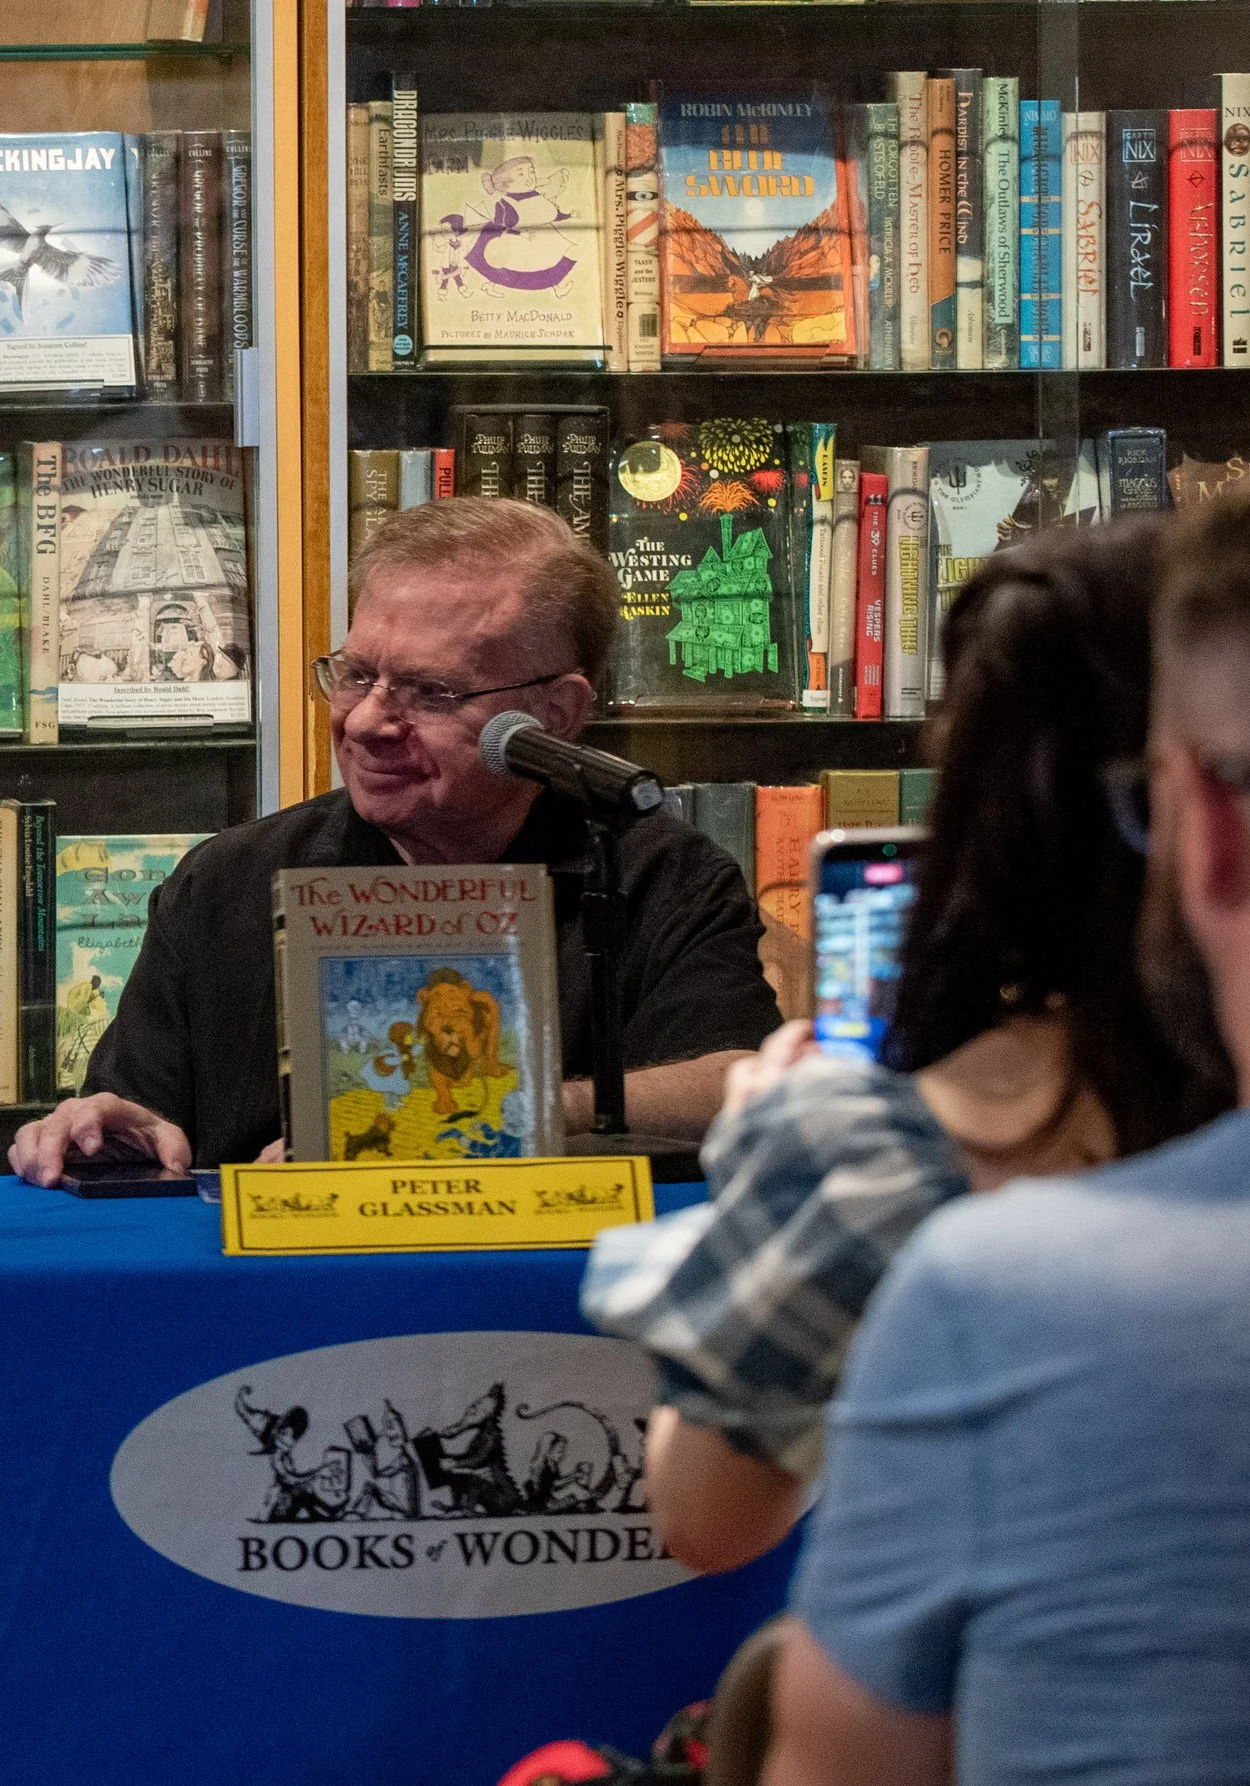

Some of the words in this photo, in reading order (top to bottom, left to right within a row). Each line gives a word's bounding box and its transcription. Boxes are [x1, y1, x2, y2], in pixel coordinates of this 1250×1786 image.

[998, 83, 1008, 144] McKinley
[1226, 108, 1250, 118] NIX
[378, 129, 390, 196] Earthfasts
[998, 150, 1009, 173] The
[1126, 142, 1154, 159] NIX
[233, 165, 246, 208] GREGOR
[686, 175, 814, 196] SWORD
[939, 150, 951, 203] HOMER
[616, 178, 626, 215] Mrs.
[998, 177, 1009, 227] Outlaws
[233, 221, 247, 256] CURSE
[939, 211, 951, 254] PRICE
[998, 232, 1009, 246] of
[612, 217, 626, 309] Piggle-Wiggle
[998, 250, 1010, 318] Sherwood
[233, 269, 248, 350] WARMBLOODS
[36, 454, 57, 497] The
[61, 447, 151, 476] ROALD
[163, 444, 241, 478] DAHL
[63, 477, 87, 492] THE
[90, 465, 171, 482] WONDERFUL
[176, 465, 216, 486] STORY
[219, 477, 238, 491] OF
[90, 478, 143, 499] HENRY
[148, 478, 203, 495] SUGAR
[439, 467, 451, 497] PULL
[365, 469, 378, 539] SPYGLA
[868, 495, 882, 504] 11
[37, 504, 56, 556] BFG
[636, 538, 665, 551] THE
[871, 529, 880, 545] 39
[609, 552, 692, 568] WESTING
[618, 569, 669, 589] GAME
[621, 592, 670, 603] ELLEN
[41, 576, 50, 655] DAHL/BLAKE
[620, 605, 670, 621] RASKIN
[866, 604, 874, 636] RISING
[114, 686, 145, 694] Inscribed
[35, 721, 55, 729] FSG
[290, 877, 342, 906] The
[350, 876, 536, 903] WONDERFUL
[310, 910, 436, 938] WIZARD
[476, 911, 519, 934] OZ
[77, 936, 141, 953] Elizabeth
[391, 1179, 482, 1195] PETER
[358, 1200, 517, 1218] GLASSMAN
[237, 1533, 414, 1572] BOOKS
[426, 1540, 448, 1563] of
